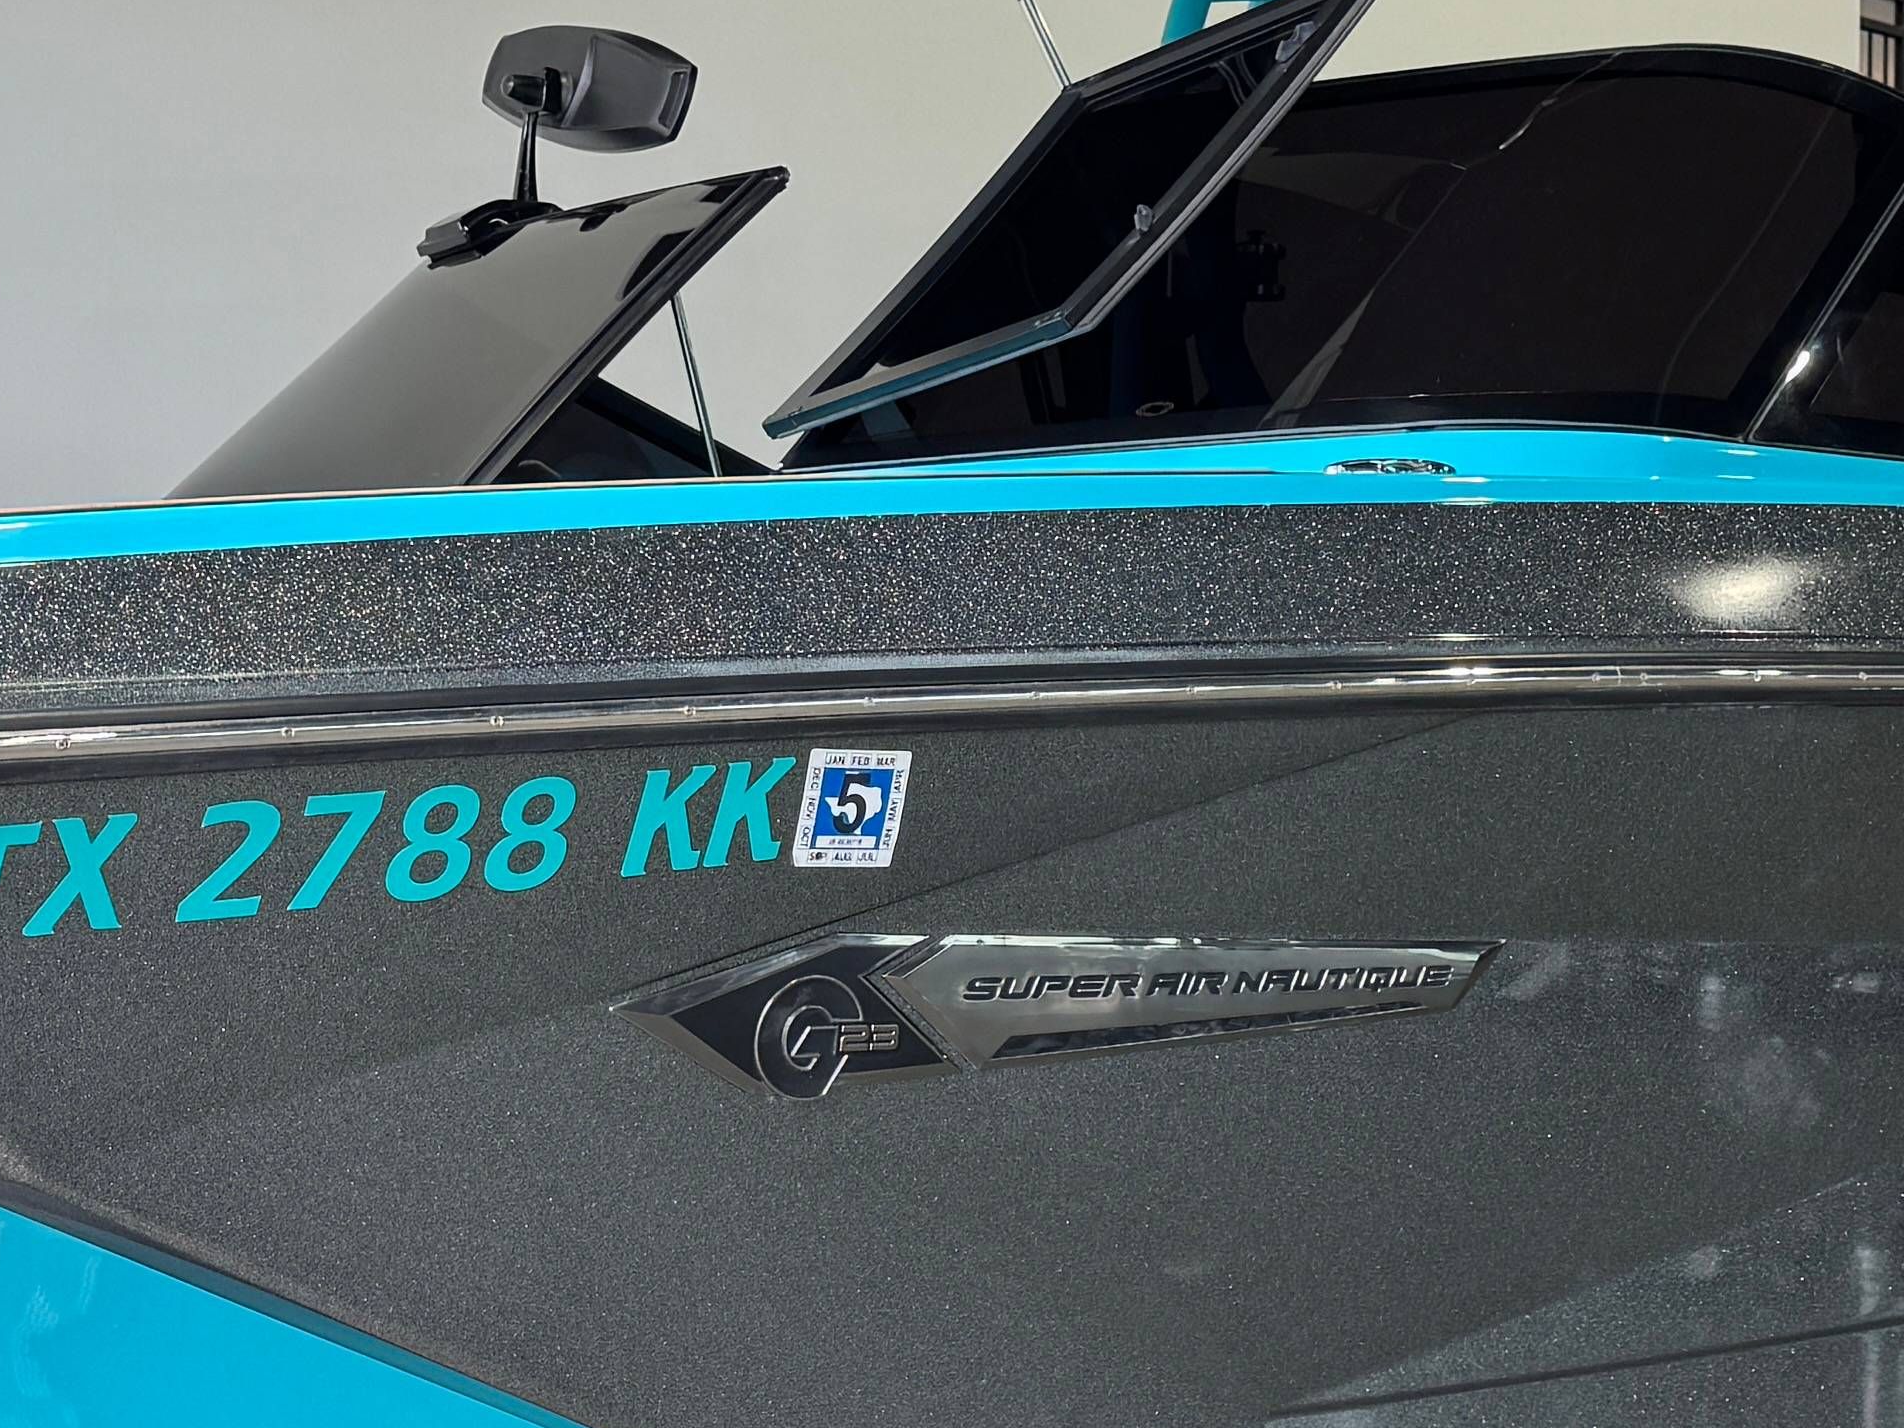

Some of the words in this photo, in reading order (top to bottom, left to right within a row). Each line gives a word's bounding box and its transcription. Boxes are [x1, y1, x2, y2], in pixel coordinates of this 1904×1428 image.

[832, 772, 872, 834] 5
[175, 777, 575, 924] 2788
[620, 756, 796, 877] KK
[962, 972, 1143, 1001] SUPER
[1146, 969, 1229, 997] AIR
[1232, 964, 1454, 994] NAUTIQUE
